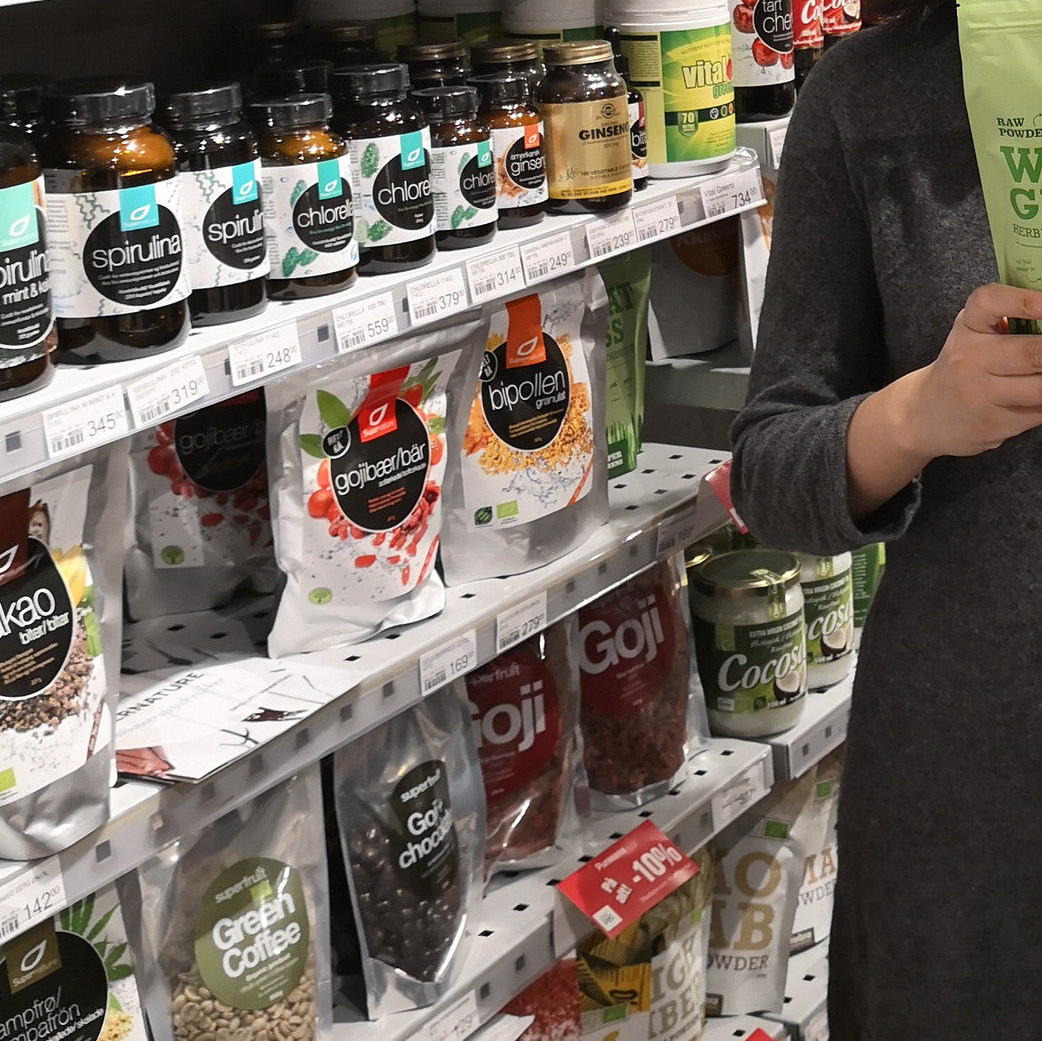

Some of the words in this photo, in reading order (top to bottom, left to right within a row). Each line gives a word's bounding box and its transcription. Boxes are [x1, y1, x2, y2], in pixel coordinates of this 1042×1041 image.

[682, 55, 731, 89] vital
[682, 112, 695, 124] 70
[997, 117, 1025, 127] RAW
[92, 233, 182, 272] spirulina
[488, 370, 566, 412] bipollen
[578, 607, 665, 675] Goji
[213, 892, 296, 951] Green
[222, 922, 301, 979] Coffee
